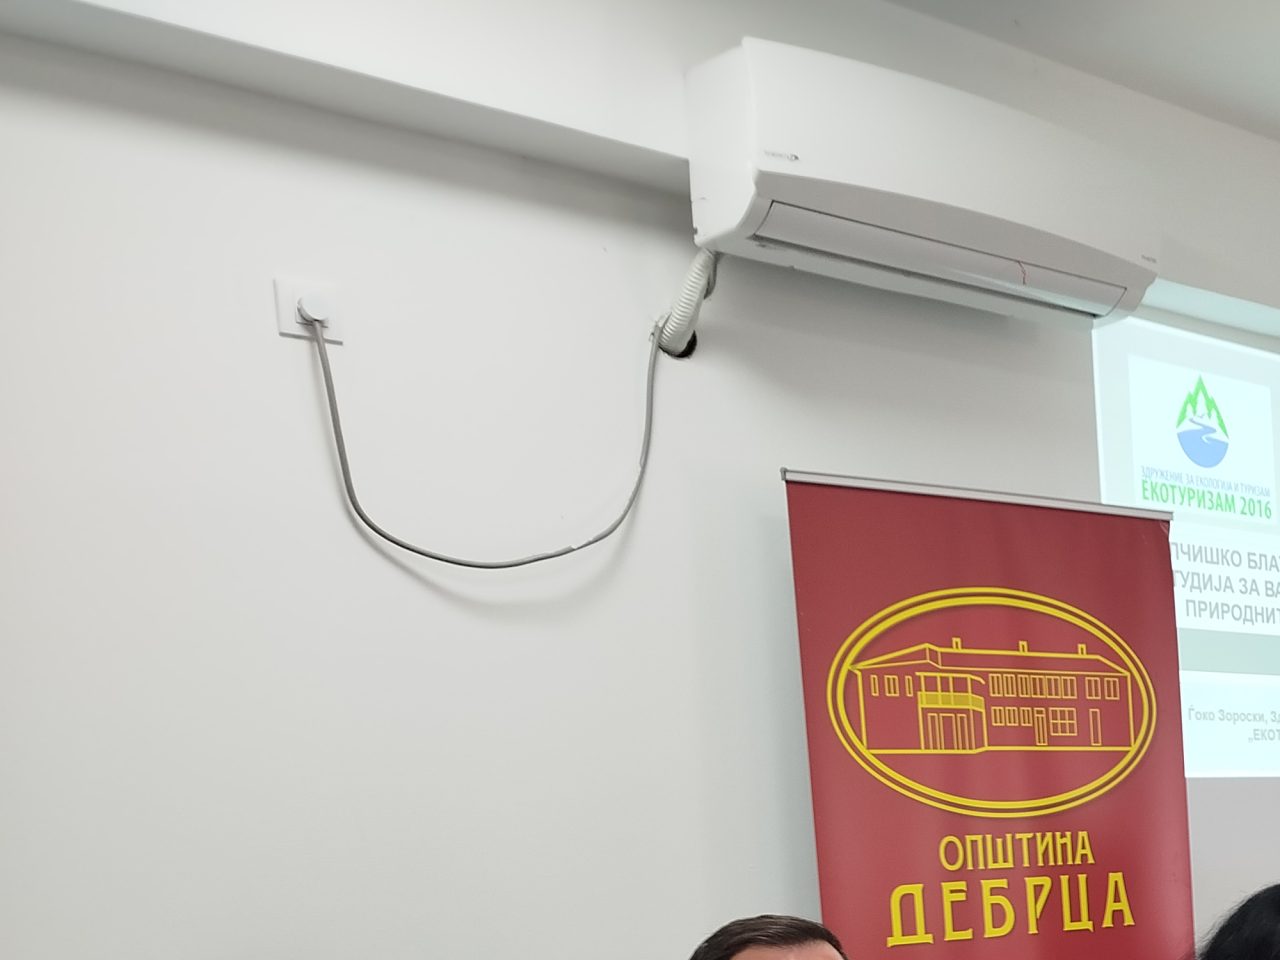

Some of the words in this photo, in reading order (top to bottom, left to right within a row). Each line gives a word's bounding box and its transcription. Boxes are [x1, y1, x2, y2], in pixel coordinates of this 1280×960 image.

[1142, 479, 1236, 514] ЕКОТУРИЗАМ
[1240, 496, 1272, 519] 2016
[1239, 577, 1260, 597] ЗА
[1218, 708, 1268, 725] Зороски,
[939, 831, 1096, 871] ОПШТИНА
[886, 871, 1136, 947] ДЕБРЦА
